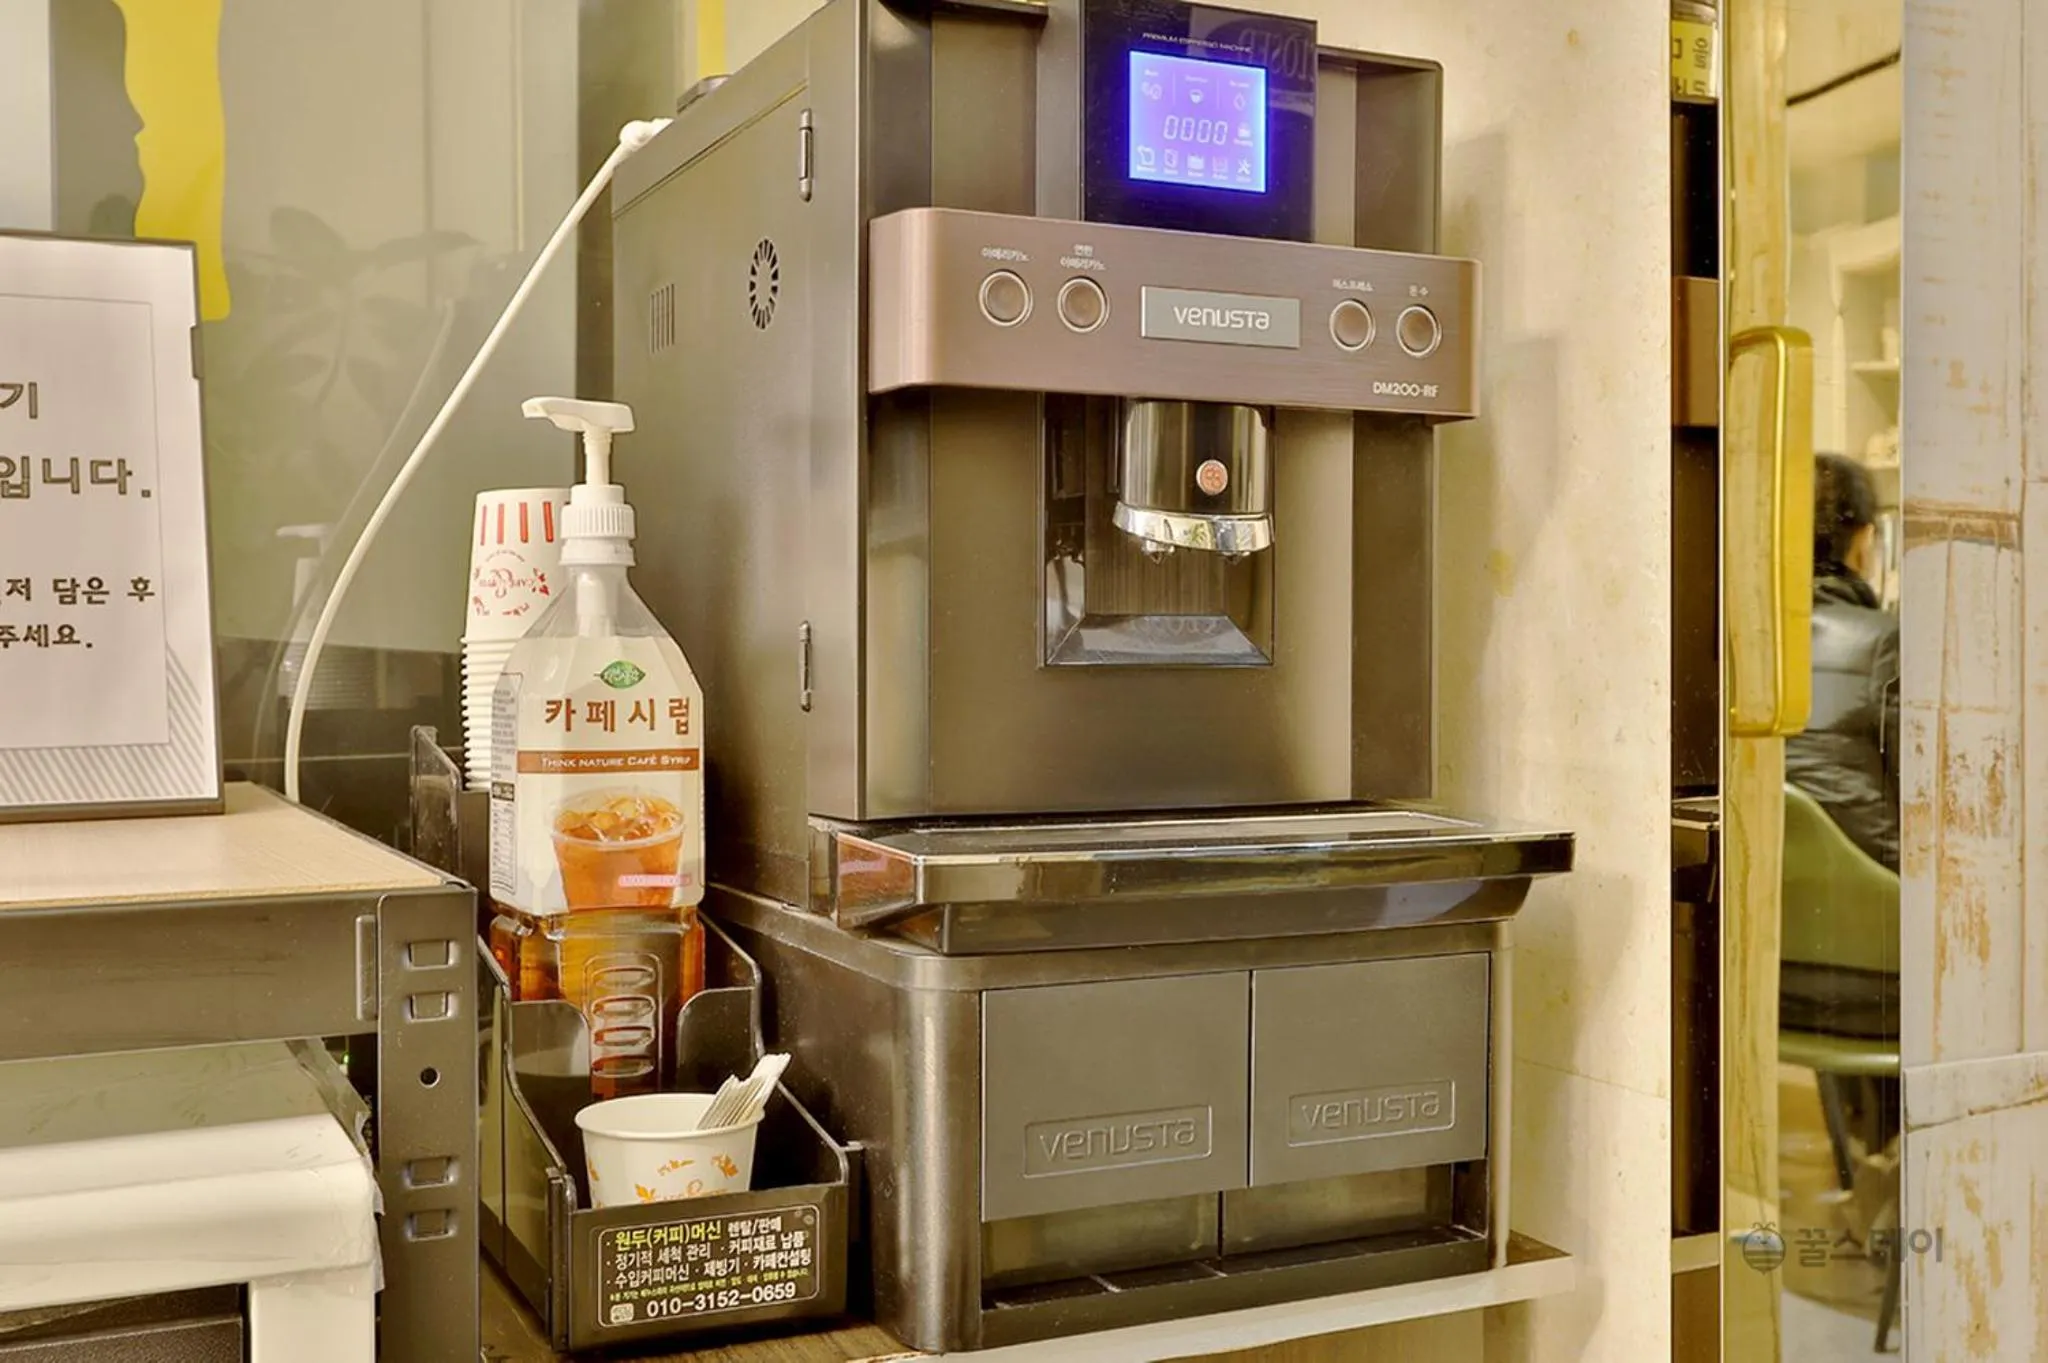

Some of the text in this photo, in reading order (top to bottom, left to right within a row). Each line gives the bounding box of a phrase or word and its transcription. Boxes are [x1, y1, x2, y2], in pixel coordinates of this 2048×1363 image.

[1163, 115, 1228, 146] 0000
[1372, 381, 1440, 398] DM200-RF
[52, 576, 110, 605] 담은
[127, 576, 156, 602] 후
[615, 1220, 721, 1251] 원두(커피)머신
[728, 1234, 777, 1255] 커피재료
[615, 1242, 711, 1271] 정기적 세척 관리
[615, 1263, 689, 1289] 수입커피머신
[753, 1247, 812, 1271] 카페컨설팅
[646, 1281, 797, 1318] 010-3152-0659
